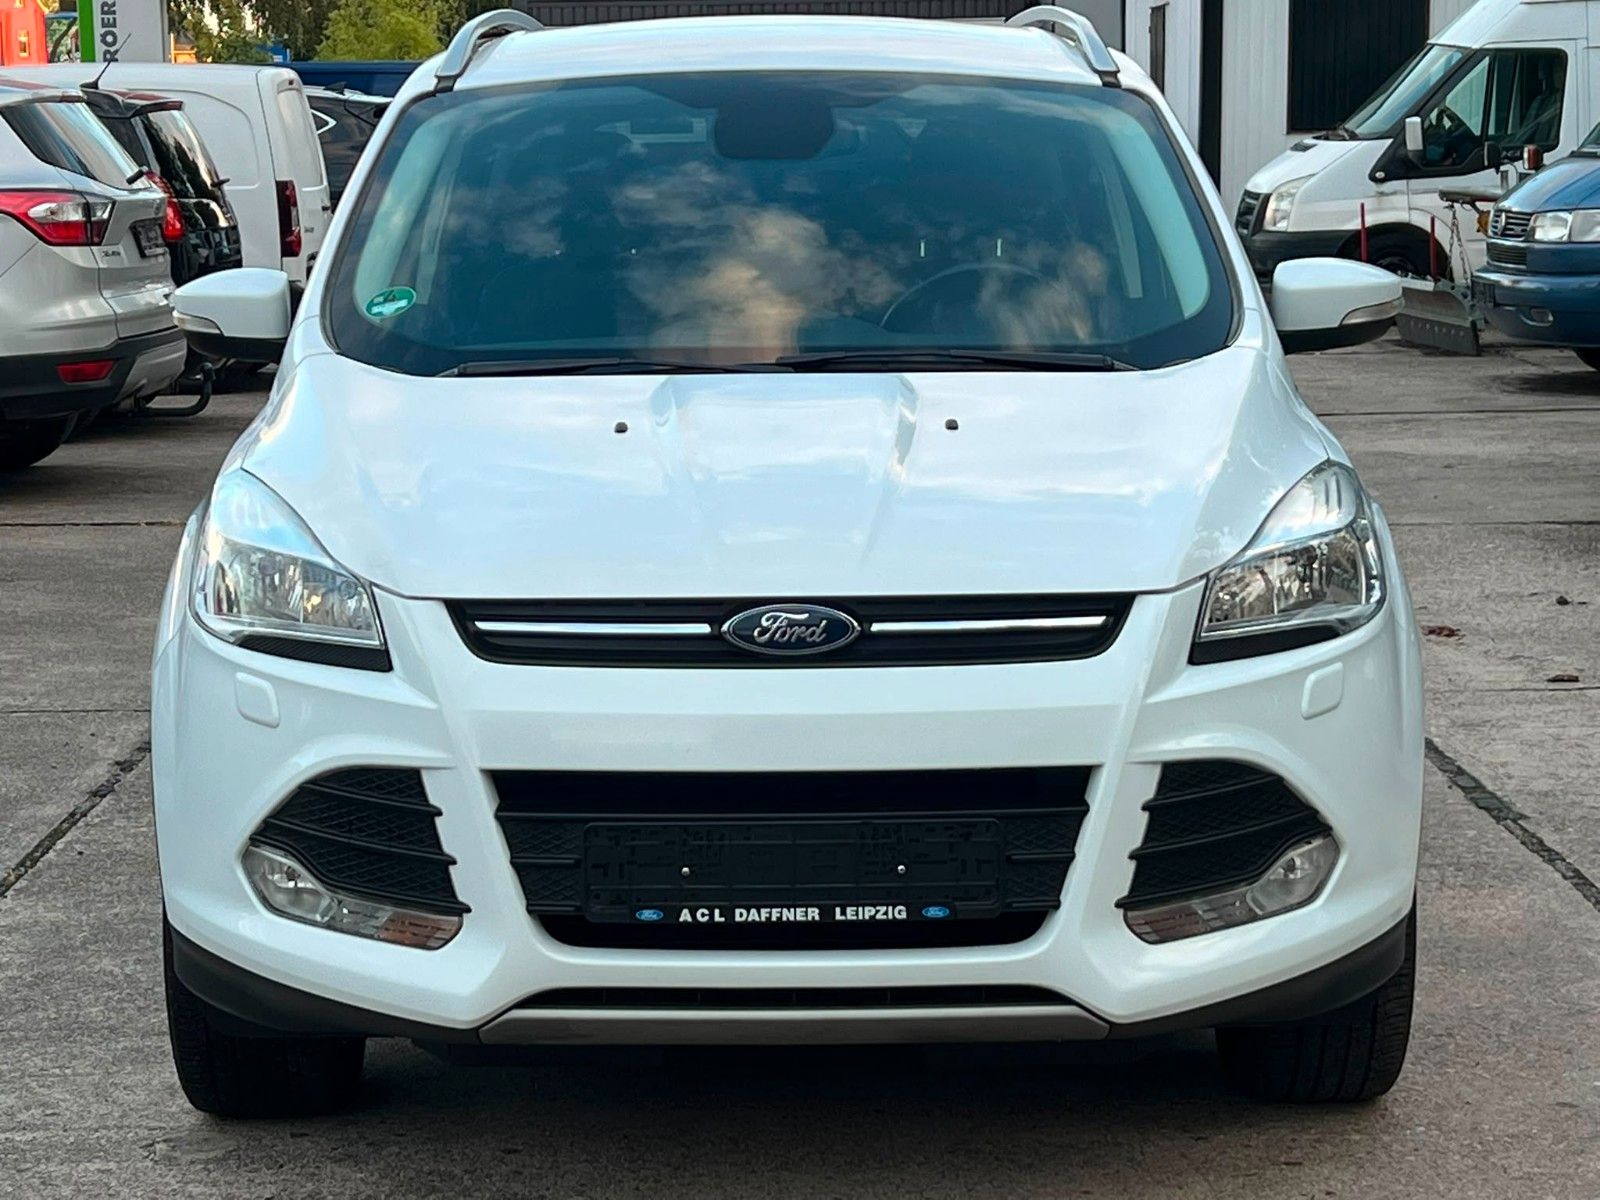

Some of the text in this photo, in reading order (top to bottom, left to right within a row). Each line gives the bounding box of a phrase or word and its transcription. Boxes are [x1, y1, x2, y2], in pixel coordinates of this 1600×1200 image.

[753, 612, 828, 643] Ford
[735, 907, 820, 922] DAFFNER
[835, 905, 907, 920] LEIPZIG
